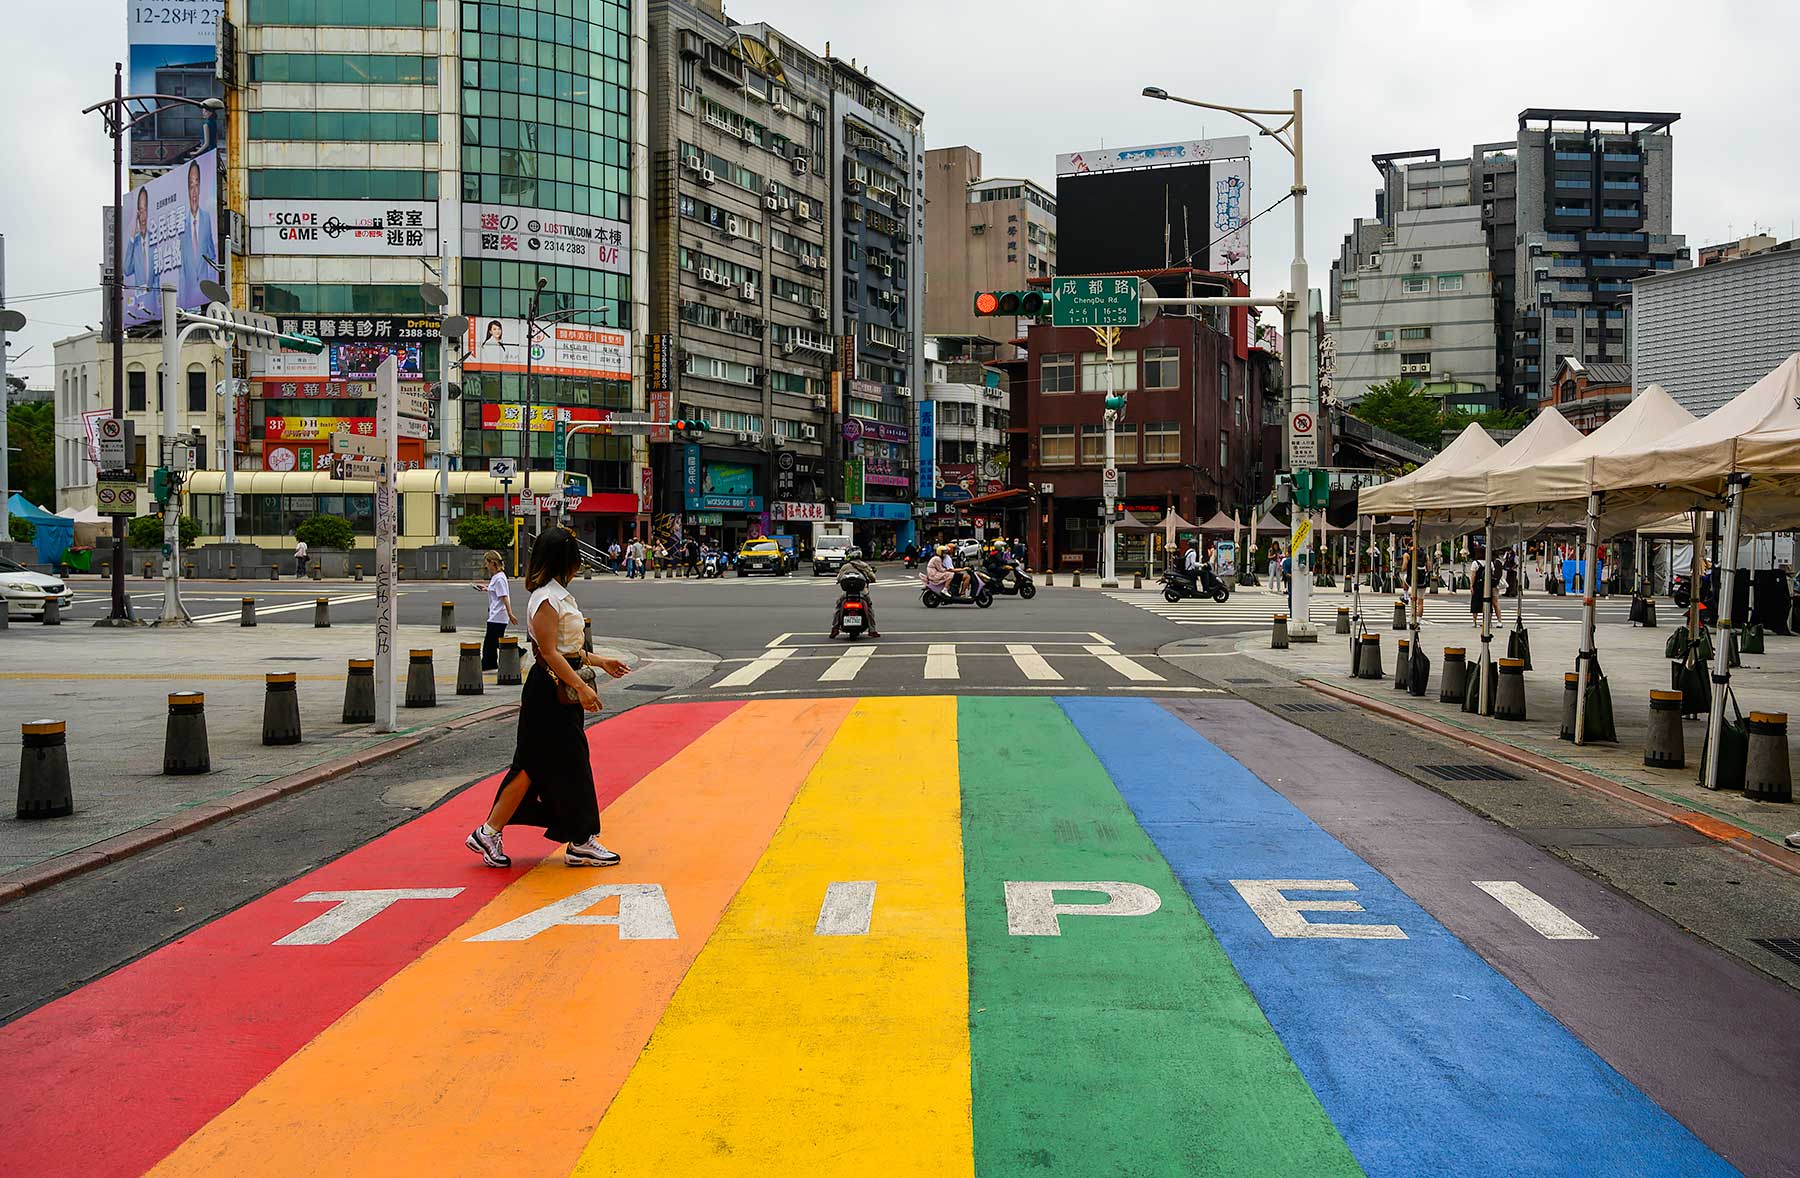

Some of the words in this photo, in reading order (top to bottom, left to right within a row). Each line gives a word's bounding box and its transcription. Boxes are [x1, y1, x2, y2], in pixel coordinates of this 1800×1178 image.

[200, 9, 226, 25] 23
[386, 209, 423, 227] 密室
[279, 227, 318, 241] GAME
[544, 222, 592, 239] LOSTTW.COM
[594, 226, 622, 246] 本棟
[599, 246, 619, 264] 6/F
[1062, 279, 1130, 295] 成都路
[399, 328, 441, 338] 2388-88
[944, 504, 956, 513] 85
